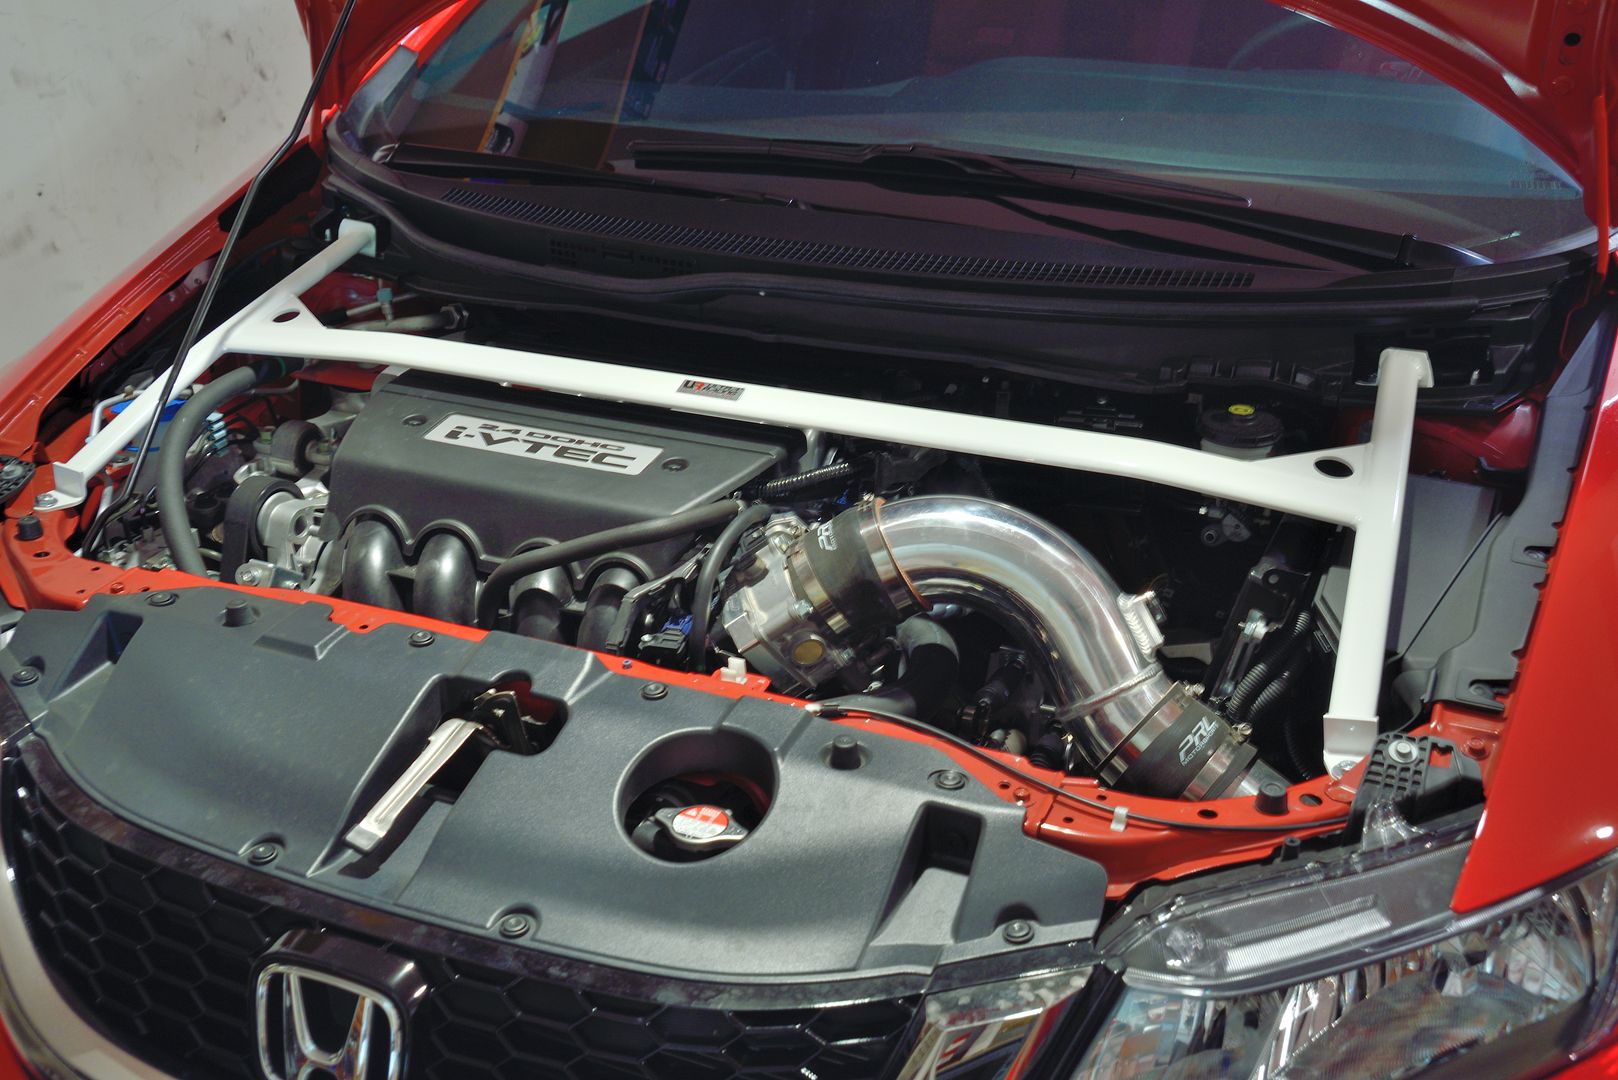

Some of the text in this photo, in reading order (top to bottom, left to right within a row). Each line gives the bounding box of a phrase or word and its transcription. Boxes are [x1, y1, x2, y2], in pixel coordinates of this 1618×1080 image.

[445, 425, 637, 469] i-VTEC
[478, 423, 625, 452] 2.4 DOHC
[1178, 716, 1217, 763] PRL
[1180, 724, 1219, 767] MOTORSPORT
